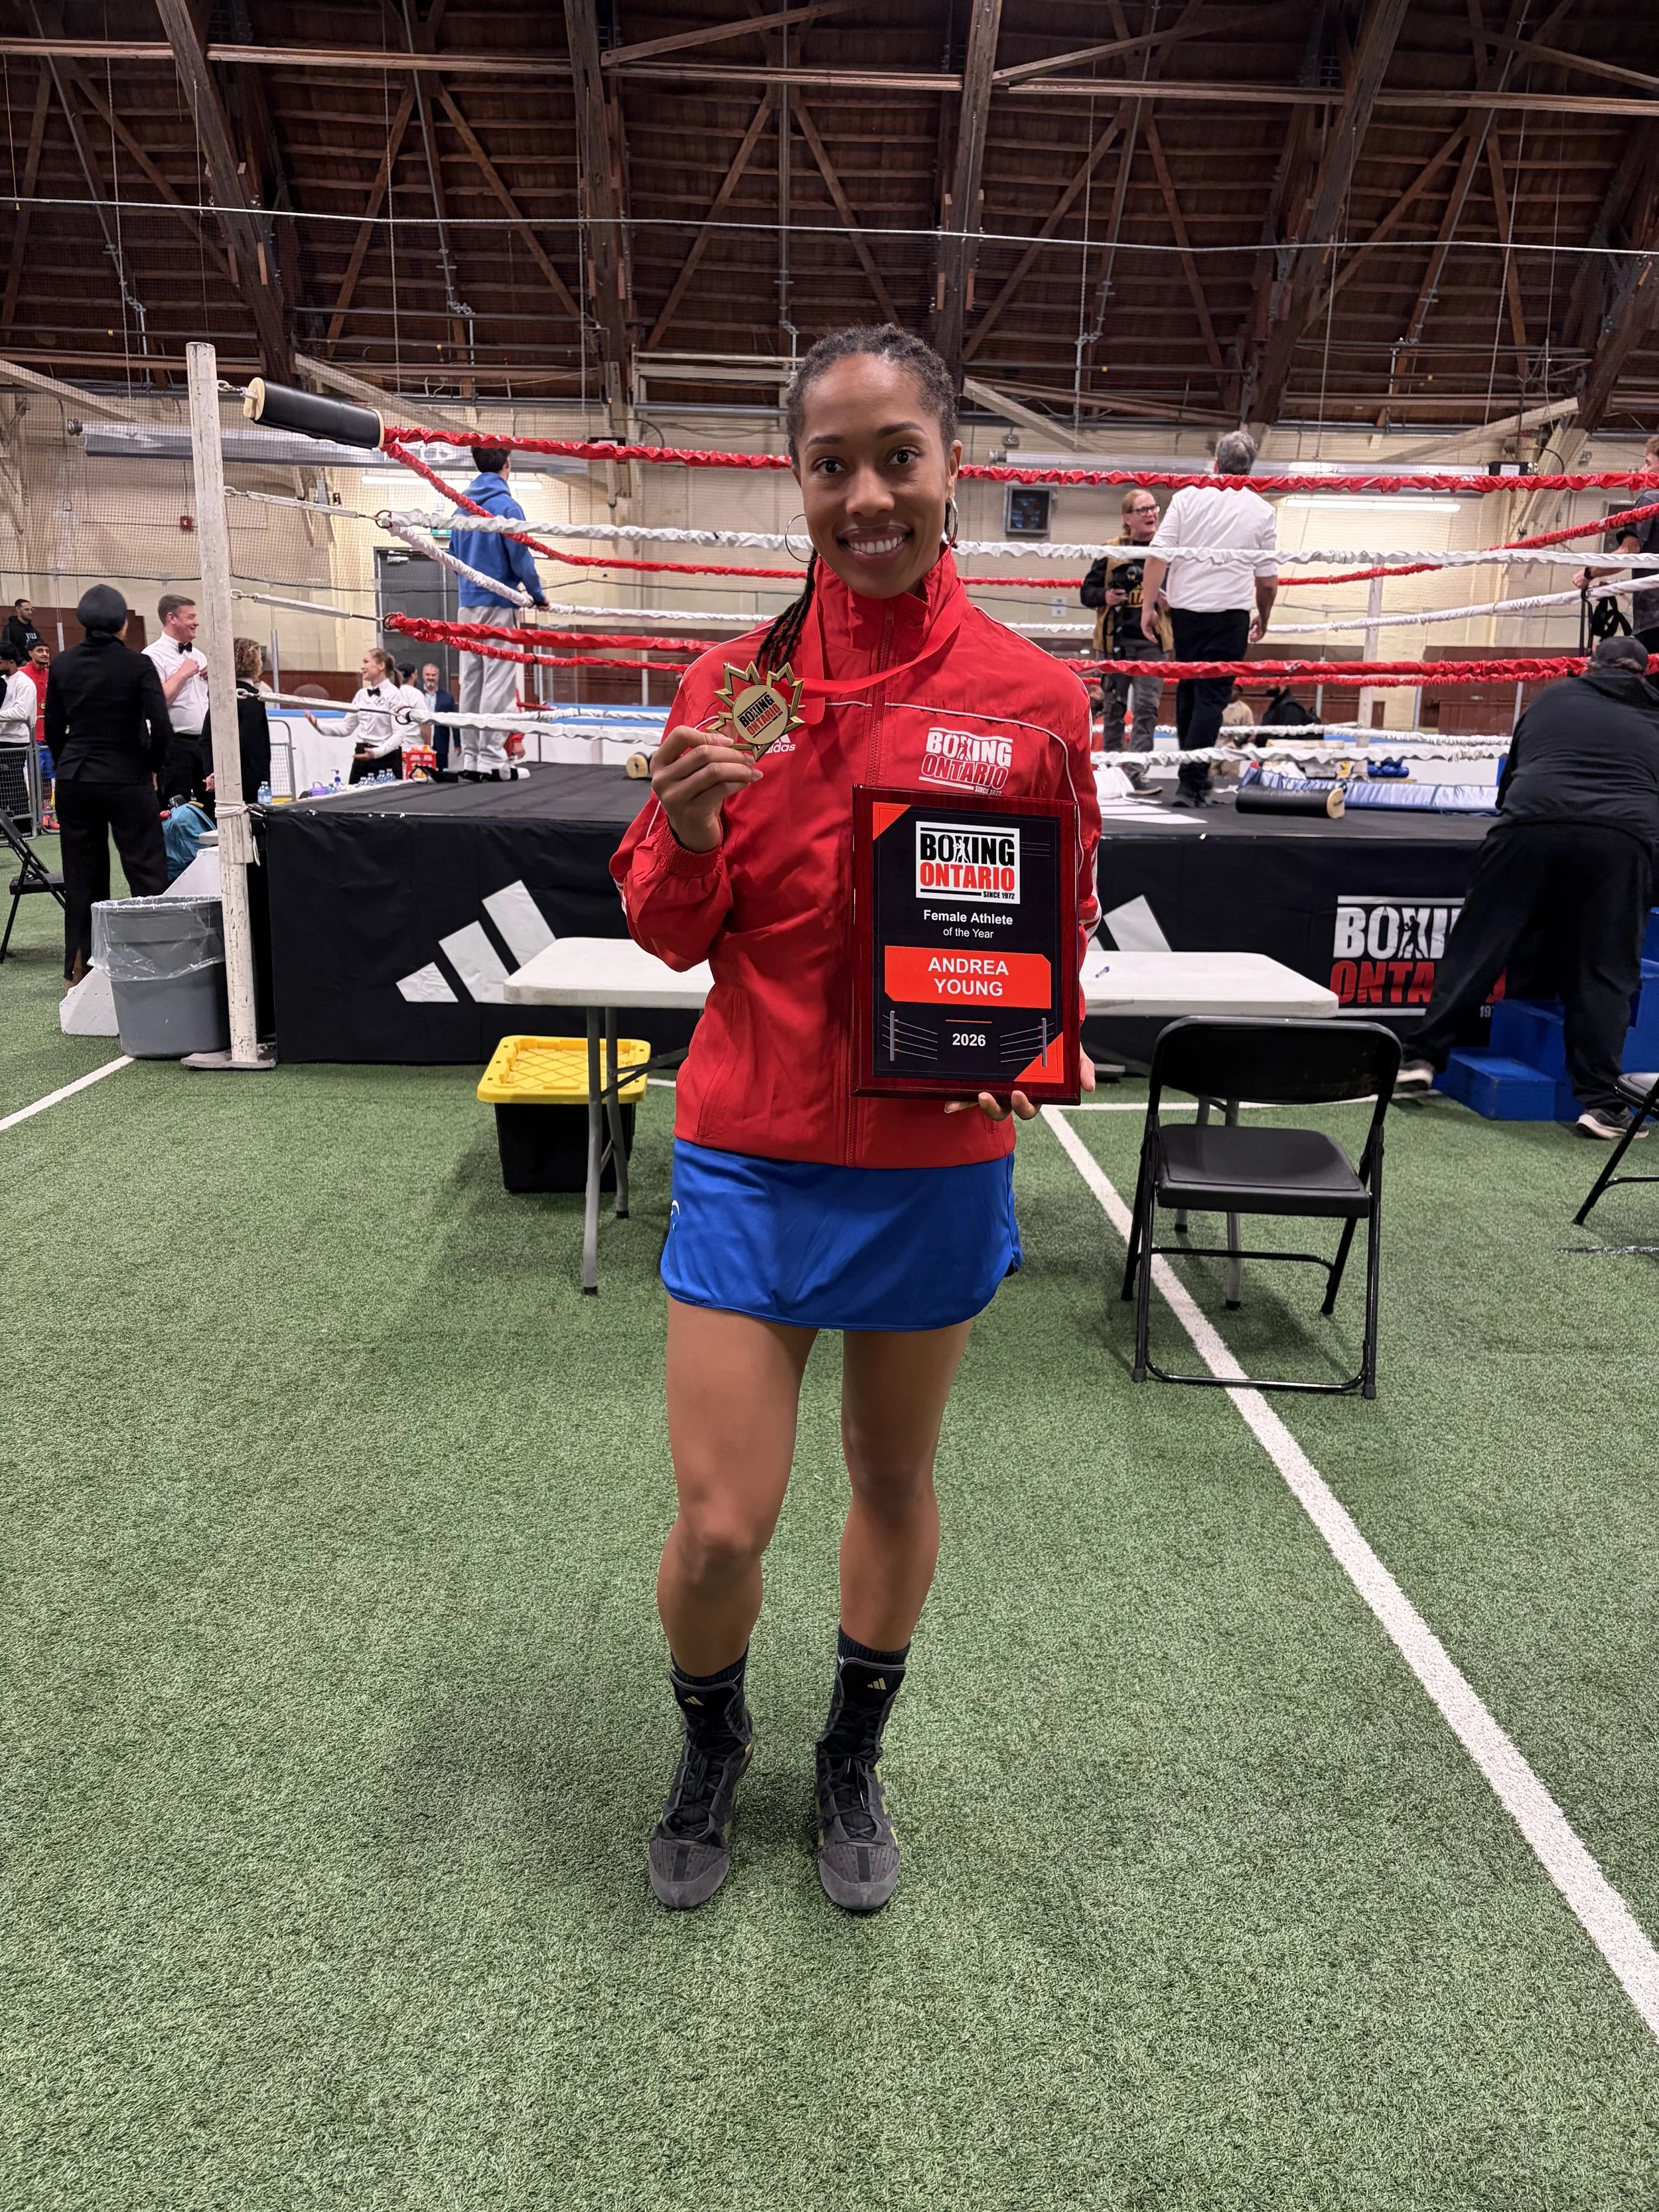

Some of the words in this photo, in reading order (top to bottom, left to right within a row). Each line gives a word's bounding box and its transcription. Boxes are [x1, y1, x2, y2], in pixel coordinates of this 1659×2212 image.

[739, 694, 775, 728] BOXING
[747, 703, 781, 735] ONTARIO
[926, 732, 1013, 767] BOXING
[921, 753, 1009, 790] ONTARIO
[974, 785, 988, 795] SINCE
[920, 833, 1015, 866] BOXING
[920, 862, 1015, 891] ONTARIO
[924, 909, 967, 922] Female
[970, 912, 1013, 925] Athlete
[943, 927, 953, 936] of
[955, 928, 970, 937] the
[972, 928, 994, 938] Year
[1333, 906, 1463, 960] BOXI
[928, 956, 1009, 976] ANDREA
[934, 978, 1003, 997] YOUNG
[1479, 1005, 1494, 1017] 19
[952, 1033, 986, 1047] 2026
